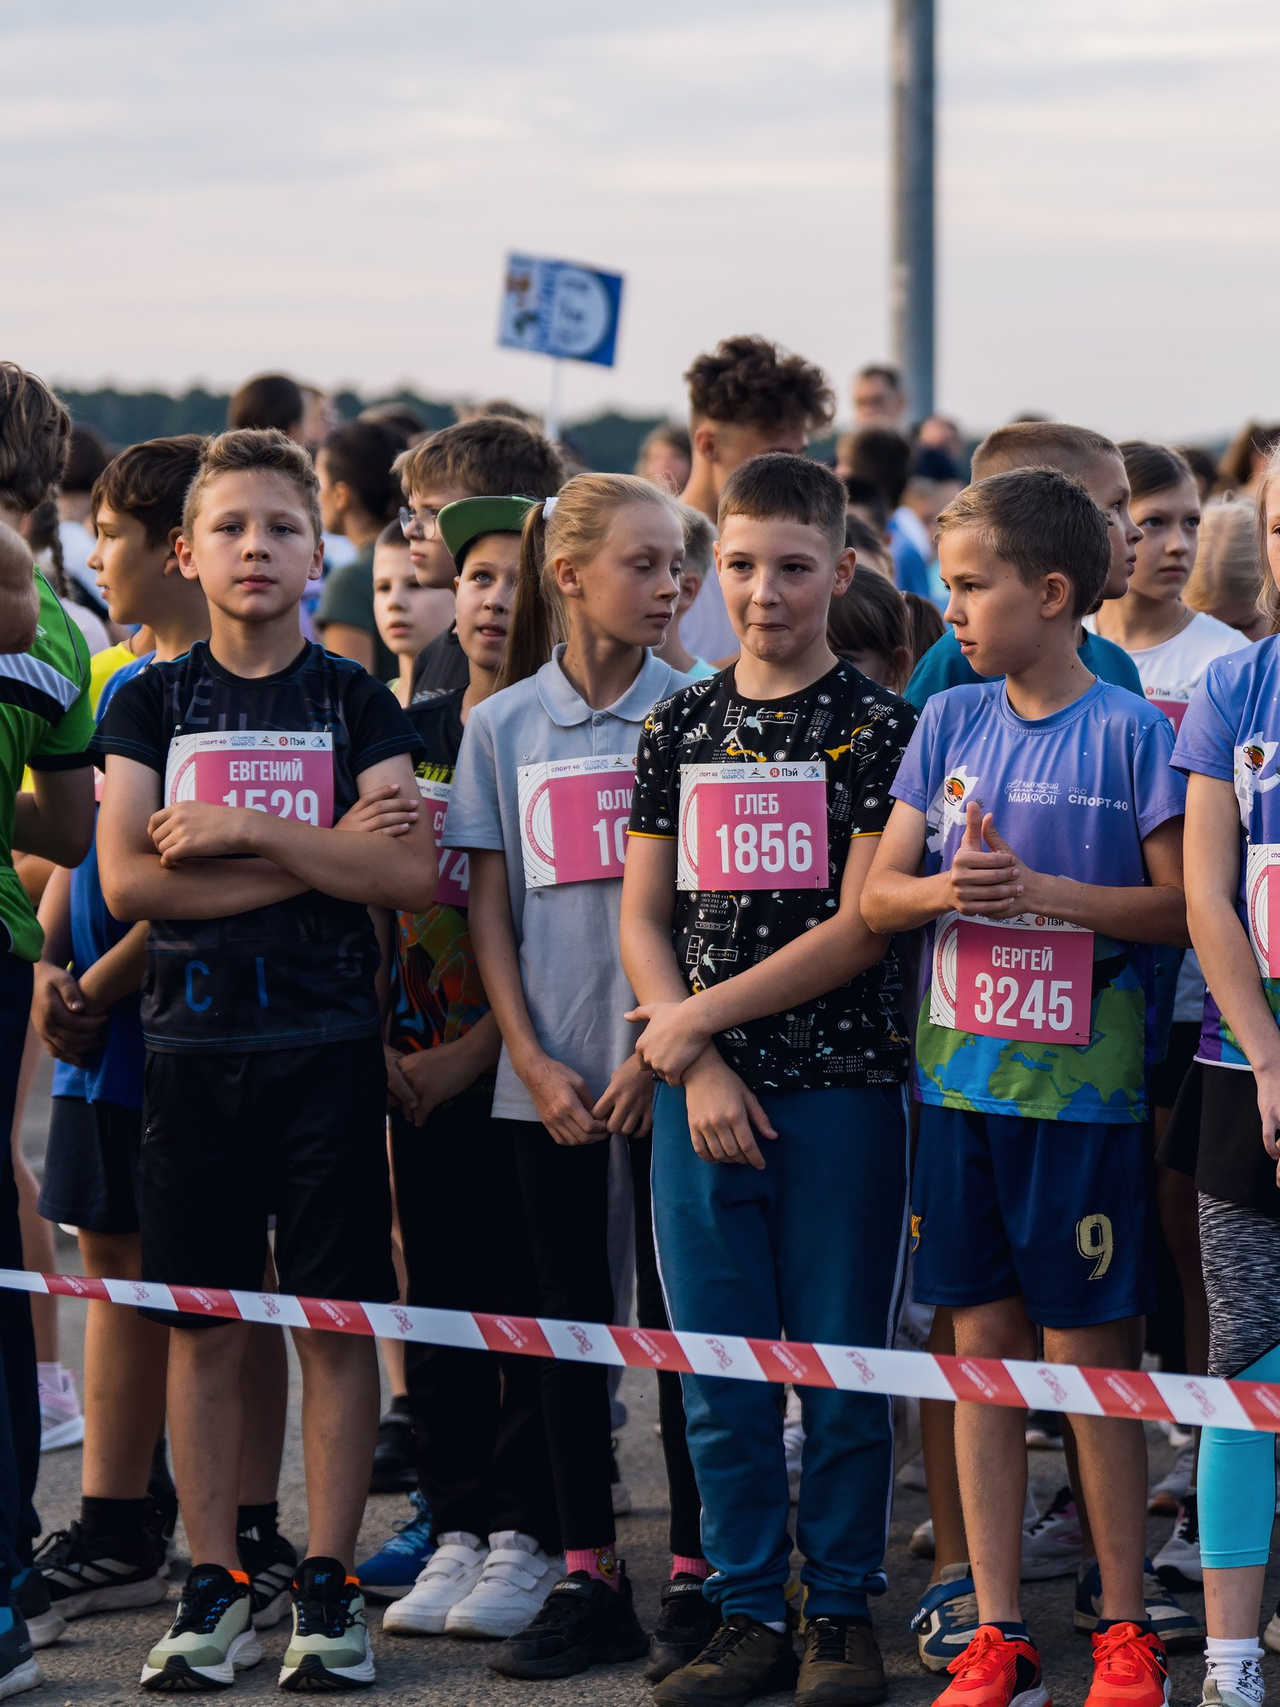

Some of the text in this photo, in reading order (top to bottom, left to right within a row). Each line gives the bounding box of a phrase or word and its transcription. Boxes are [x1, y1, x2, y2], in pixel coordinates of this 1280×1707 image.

[290, 737, 305, 746] Пэй
[229, 758, 303, 781] ЕВГЕНИЙ
[782, 768, 798, 777] Пэй
[1008, 792, 1056, 805] МАРАФОН
[1068, 786, 1087, 795] PRO
[735, 793, 779, 815] ГЛЕБ
[1068, 794, 1128, 811] СПОРТ 40
[716, 822, 812, 873] 1856
[992, 945, 1053, 971] СЕРГЕЙ
[974, 973, 1073, 1031] 3245
[1075, 1213, 1113, 1280] 9
